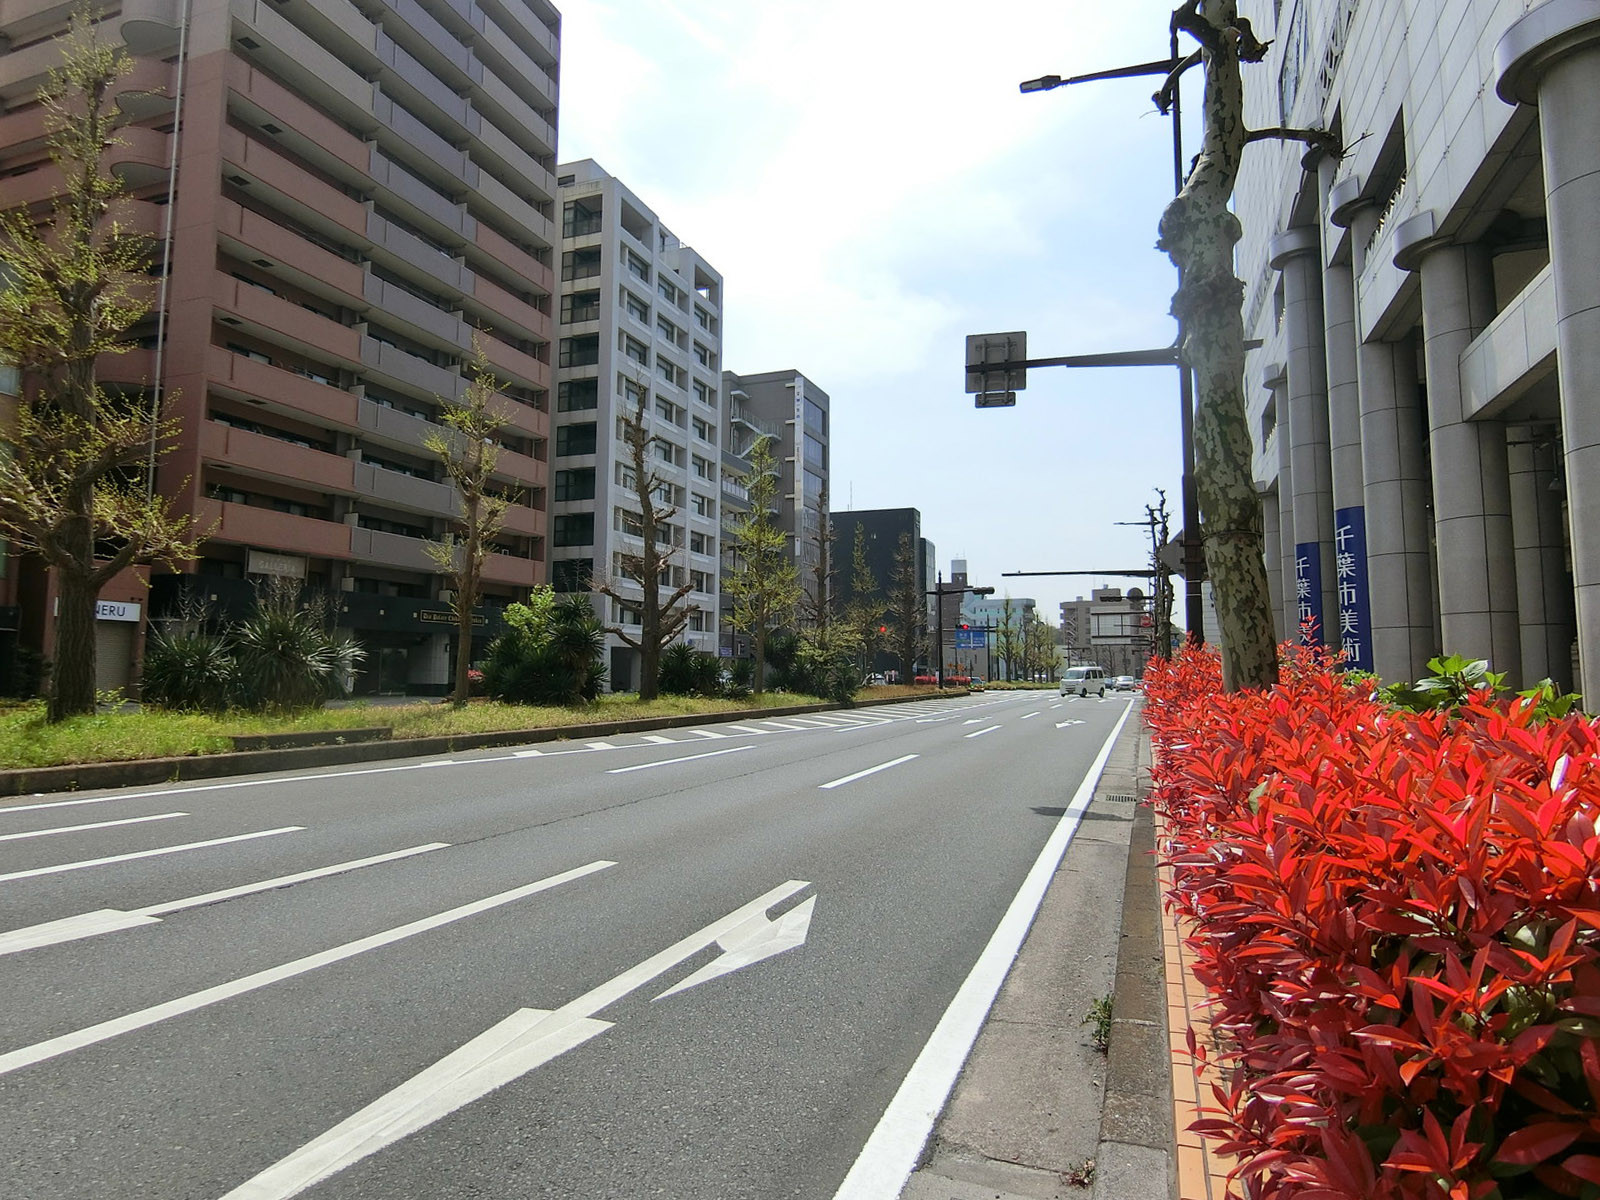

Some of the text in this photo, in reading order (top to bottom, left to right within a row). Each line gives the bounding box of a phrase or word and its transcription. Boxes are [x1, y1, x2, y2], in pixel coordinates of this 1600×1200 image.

[1336, 525, 1361, 673] 千葉市美術
